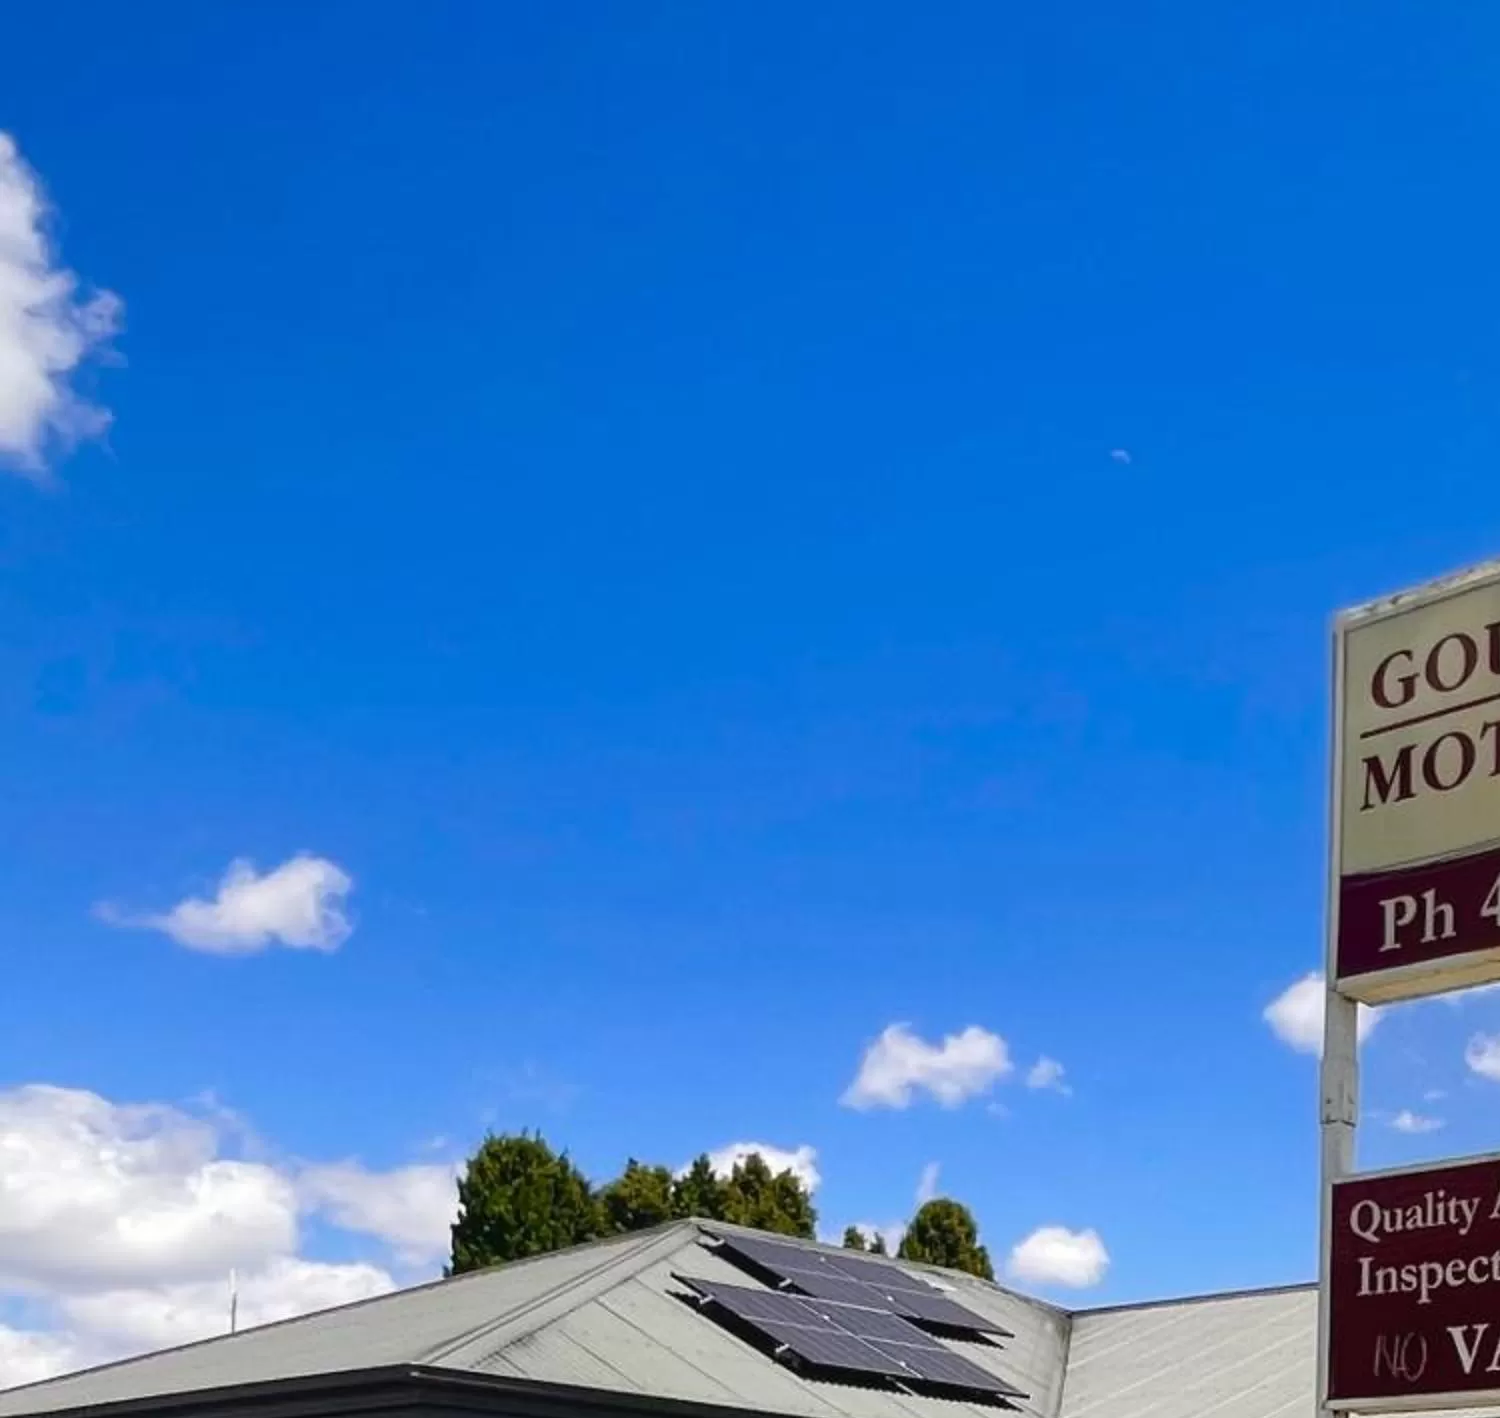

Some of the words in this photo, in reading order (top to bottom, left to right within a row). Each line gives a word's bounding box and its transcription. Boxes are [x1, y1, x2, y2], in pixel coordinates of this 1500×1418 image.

[1379, 890, 1457, 952] Ph
[1349, 1195, 1482, 1244] Quality
[1373, 1331, 1427, 1382] NO
